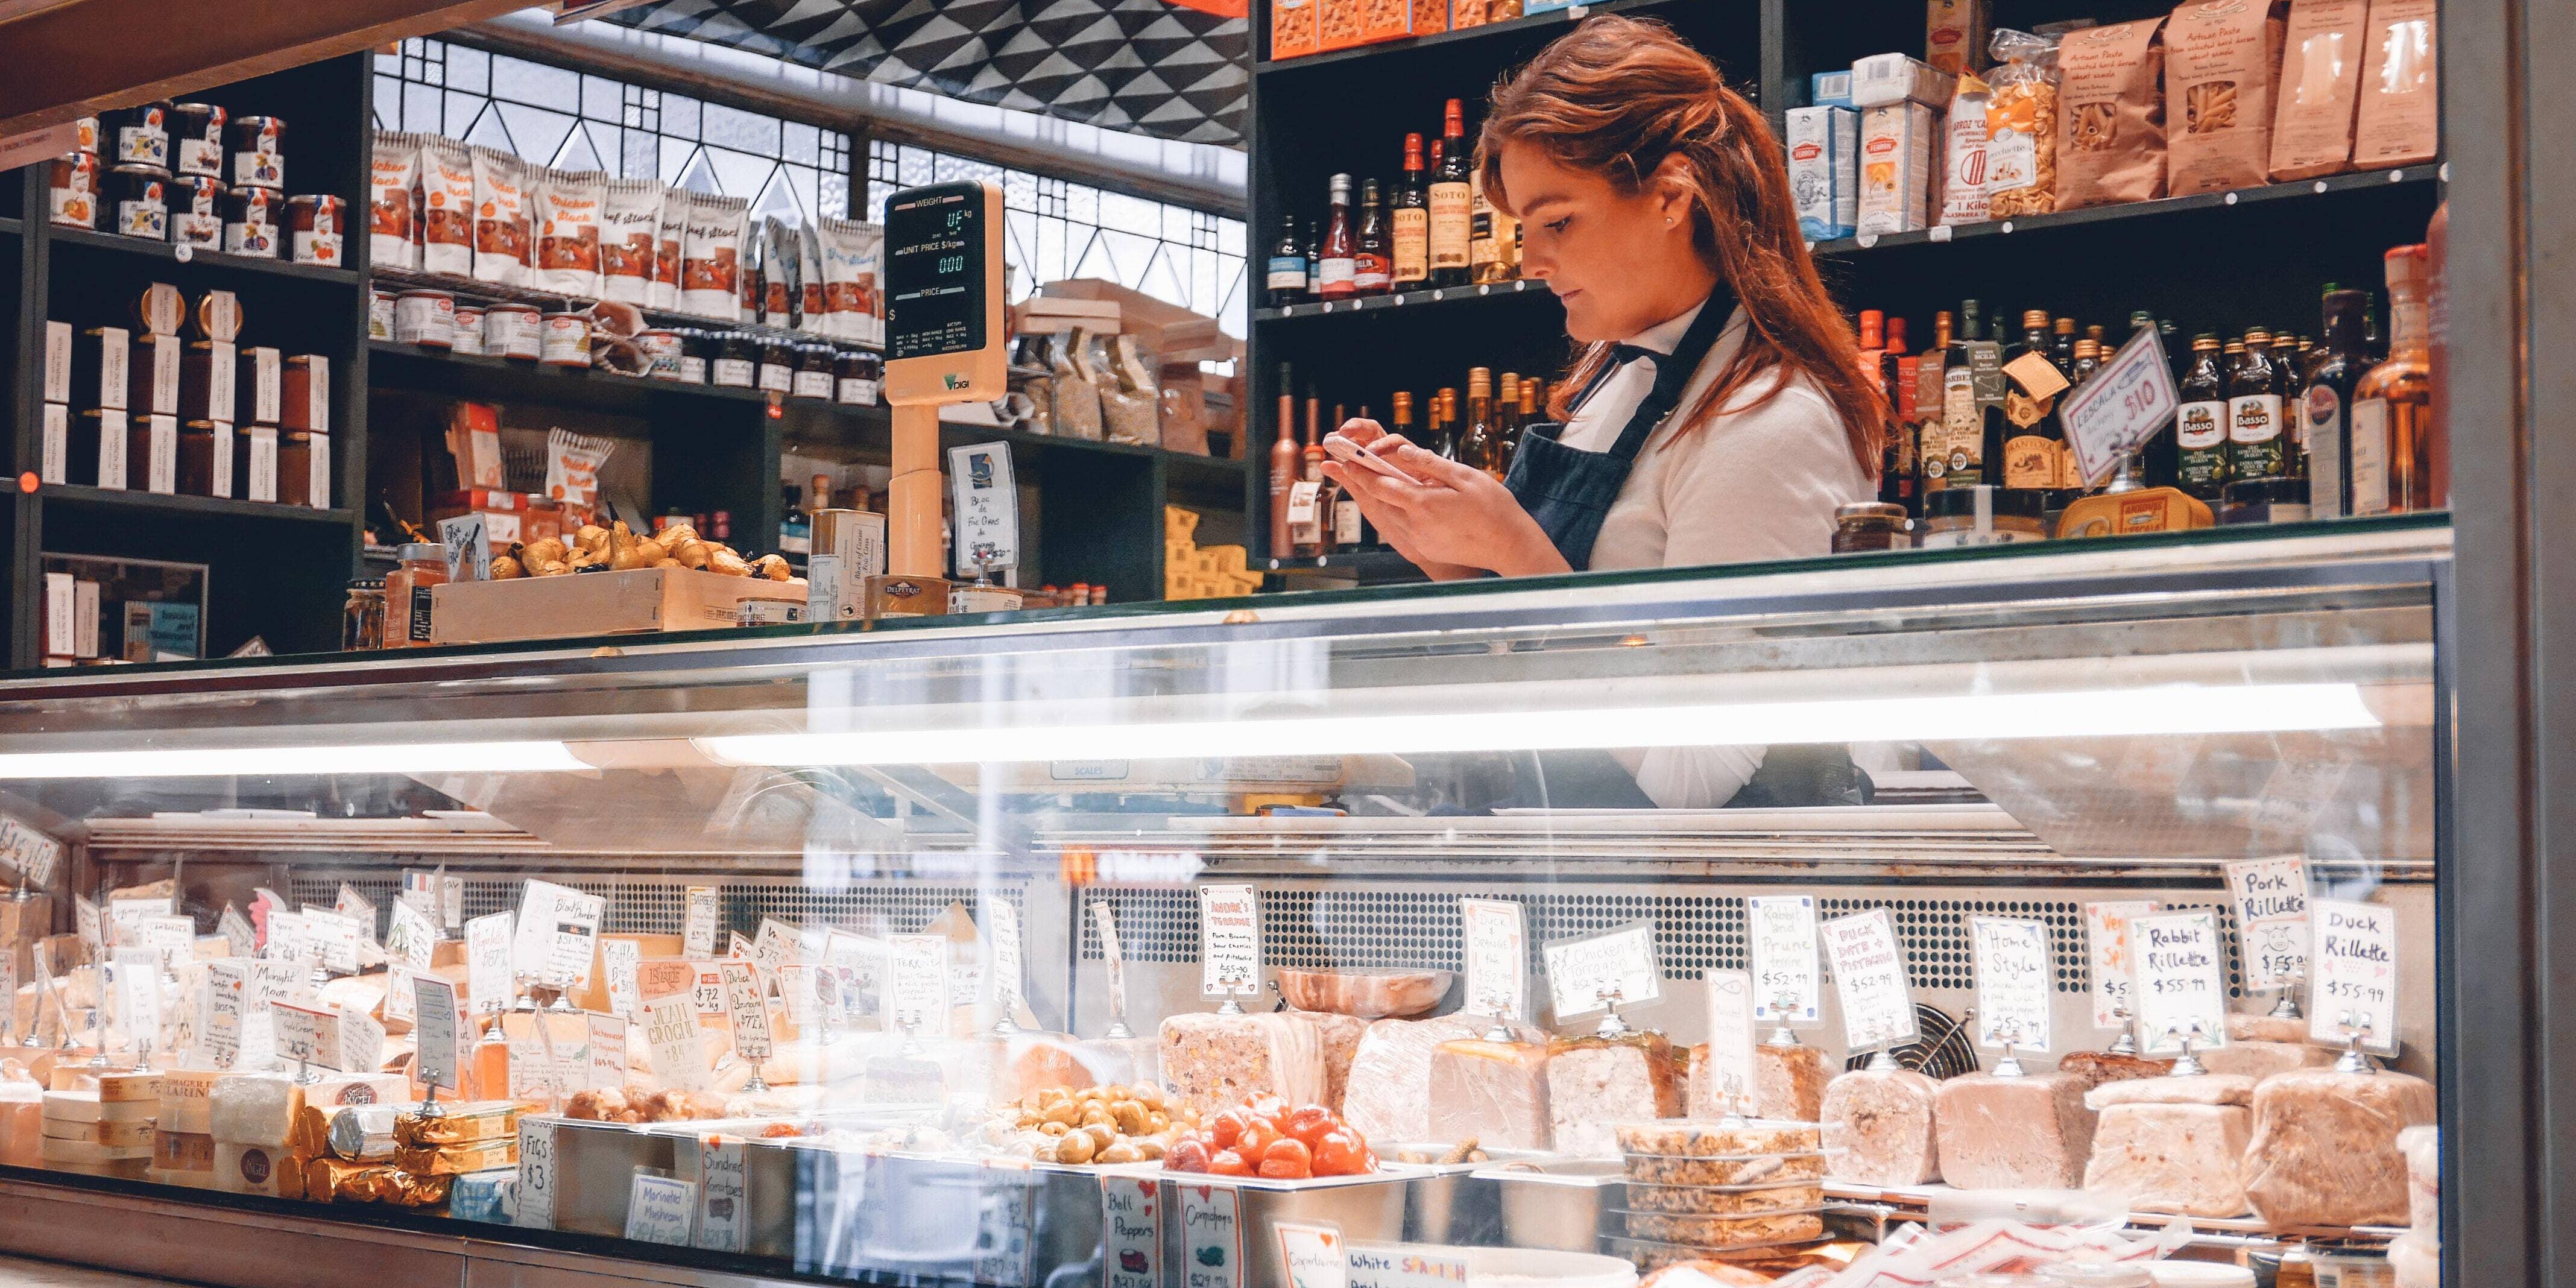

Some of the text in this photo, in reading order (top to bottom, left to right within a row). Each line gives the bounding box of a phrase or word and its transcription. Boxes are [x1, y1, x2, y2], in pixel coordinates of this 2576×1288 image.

[2220, 28, 2240, 36] Pasta
[915, 196, 942, 209] WEIGHT
[1434, 191, 1466, 200] SOTO
[1967, 200, 1988, 210] Kilo
[964, 210, 972, 219] kg
[903, 244, 919, 256] UNIT
[921, 242, 939, 253] PRICE
[920, 287, 941, 297] PRICE
[889, 309, 895, 321] $
[953, 380, 969, 390] DIGI
[1948, 374, 1972, 383] ARBE
[2124, 380, 2156, 421] $10
[2185, 422, 2213, 432] Basso
[2238, 416, 2268, 426] Basso
[886, 586, 921, 595] DELPEYRAT
[1074, 766, 1103, 776] SCALES
[2246, 872, 2287, 894] Pork
[555, 898, 576, 912] Black
[1763, 904, 1803, 923] Rabbit
[2245, 895, 2305, 921] Rillette
[1772, 921, 1796, 933] and
[2102, 913, 2124, 932] Ven
[2329, 912, 2381, 934] Duck
[1473, 936, 1509, 949] ORANGE
[1761, 936, 1811, 953] Prune
[1989, 929, 2031, 950] Home
[2150, 927, 2200, 948] Rabbit
[605, 942, 636, 966] Truffle
[1574, 942, 1625, 964] Chicken
[1837, 941, 1870, 959] DATE
[2325, 935, 2390, 962] Rillette
[1840, 952, 1894, 973] PISTACHIO
[1992, 952, 2036, 980] Style
[2102, 946, 2126, 971] Spi
[2148, 950, 2210, 973] Rillette
[254, 966, 297, 985] Midnight
[1568, 959, 1627, 980] Tarragon
[1762, 968, 1808, 987] $52.99
[258, 985, 289, 999] Moon
[2153, 978, 2206, 995] $55.99
[2326, 979, 2384, 1002] $55.99
[653, 1002, 689, 1026] JEAN
[526, 1134, 548, 1160] FIGS
[527, 1164, 545, 1190] $3
[643, 1186, 681, 1205] Marinated
[1108, 1192, 1132, 1211] Bell
[1114, 1216, 1154, 1241] Peppers
[1350, 1254, 1391, 1270] White
